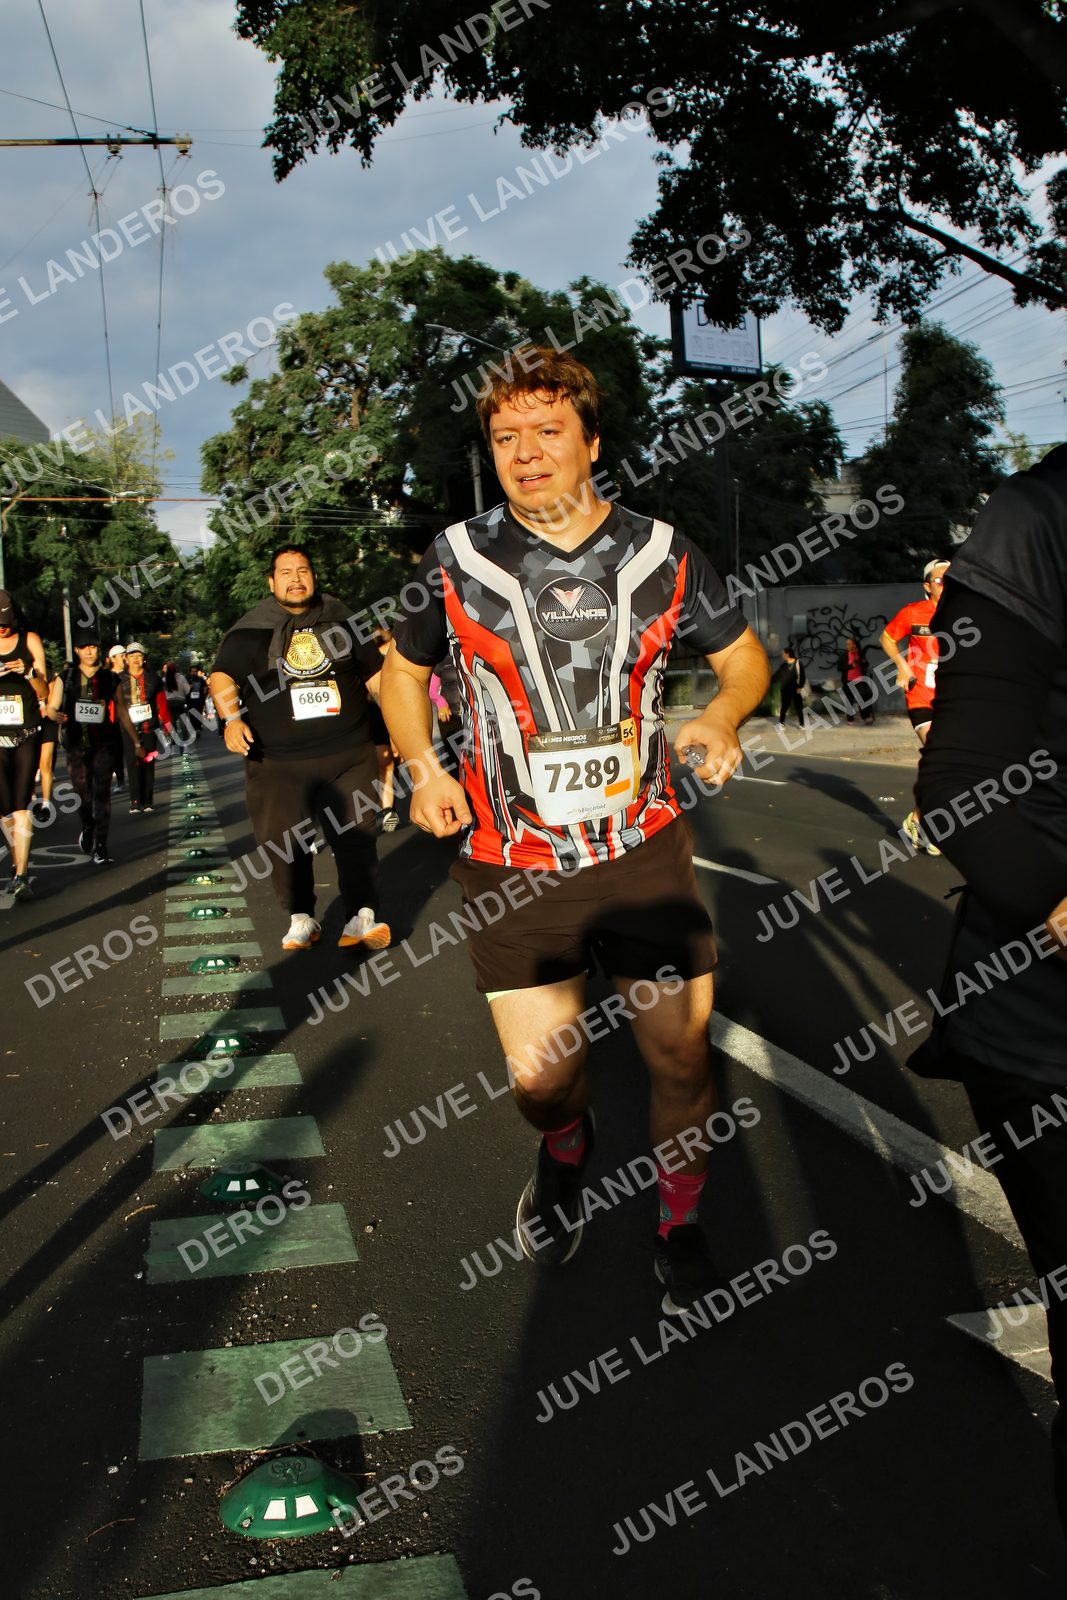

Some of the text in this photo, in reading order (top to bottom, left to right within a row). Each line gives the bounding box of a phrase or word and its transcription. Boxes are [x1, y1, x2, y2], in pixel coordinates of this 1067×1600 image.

[542, 608, 607, 622] VILLANOS
[808, 603, 848, 620] TOY
[299, 691, 330, 705] 6869
[79, 705, 99, 715] 2562
[623, 726, 634, 739] 5K
[541, 736, 562, 744] LENES
[544, 755, 620, 793] 7289
